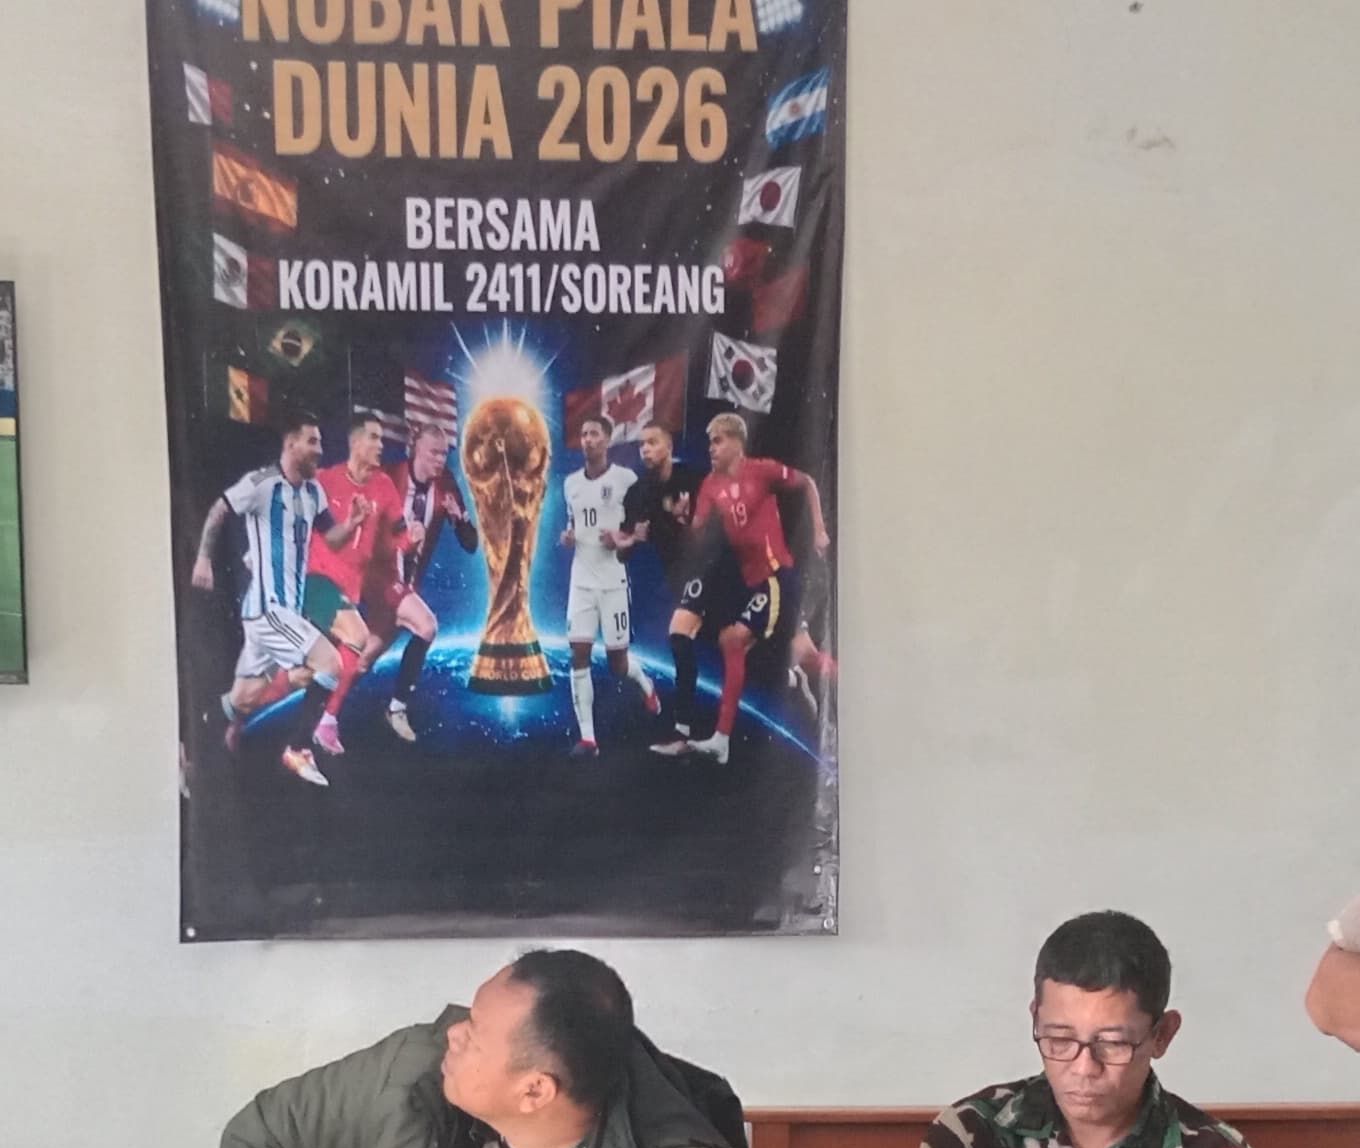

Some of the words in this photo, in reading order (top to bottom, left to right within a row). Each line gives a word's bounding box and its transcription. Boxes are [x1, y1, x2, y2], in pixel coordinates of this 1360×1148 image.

[540, 0, 758, 52] PIALA
[273, 59, 513, 159] DUNIA
[539, 63, 728, 163] 2026
[405, 197, 600, 251] BERSAMA
[278, 260, 453, 313] KORAMIL
[466, 263, 726, 314] 2411/SOREANG
[583, 508, 597, 527] 10
[730, 502, 748, 527] 19
[613, 611, 628, 632] 10
